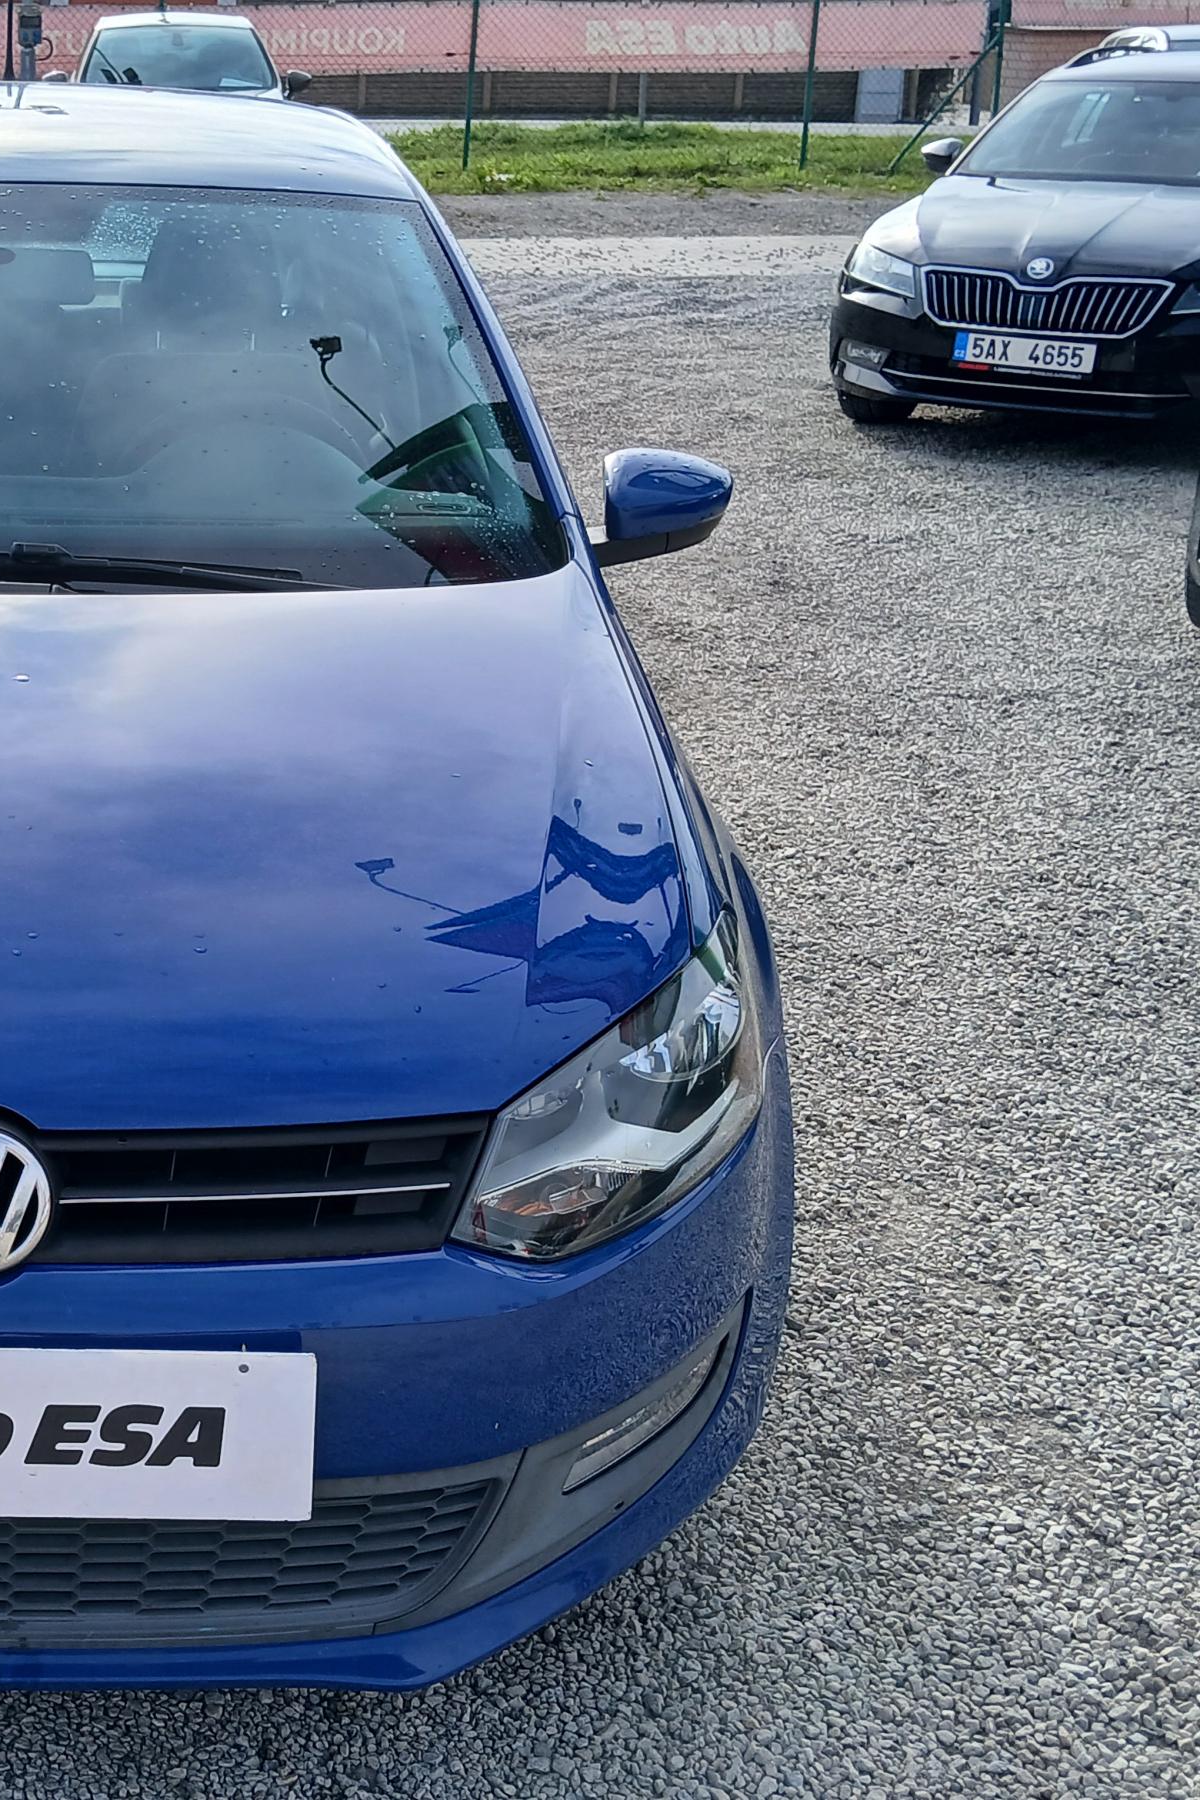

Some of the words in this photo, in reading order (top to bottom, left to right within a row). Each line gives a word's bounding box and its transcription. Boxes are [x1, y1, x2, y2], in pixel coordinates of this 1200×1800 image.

[972, 337, 1011, 362] 5AX
[1028, 343, 1085, 368] 4655
[24, 1404, 227, 1467] ESA
